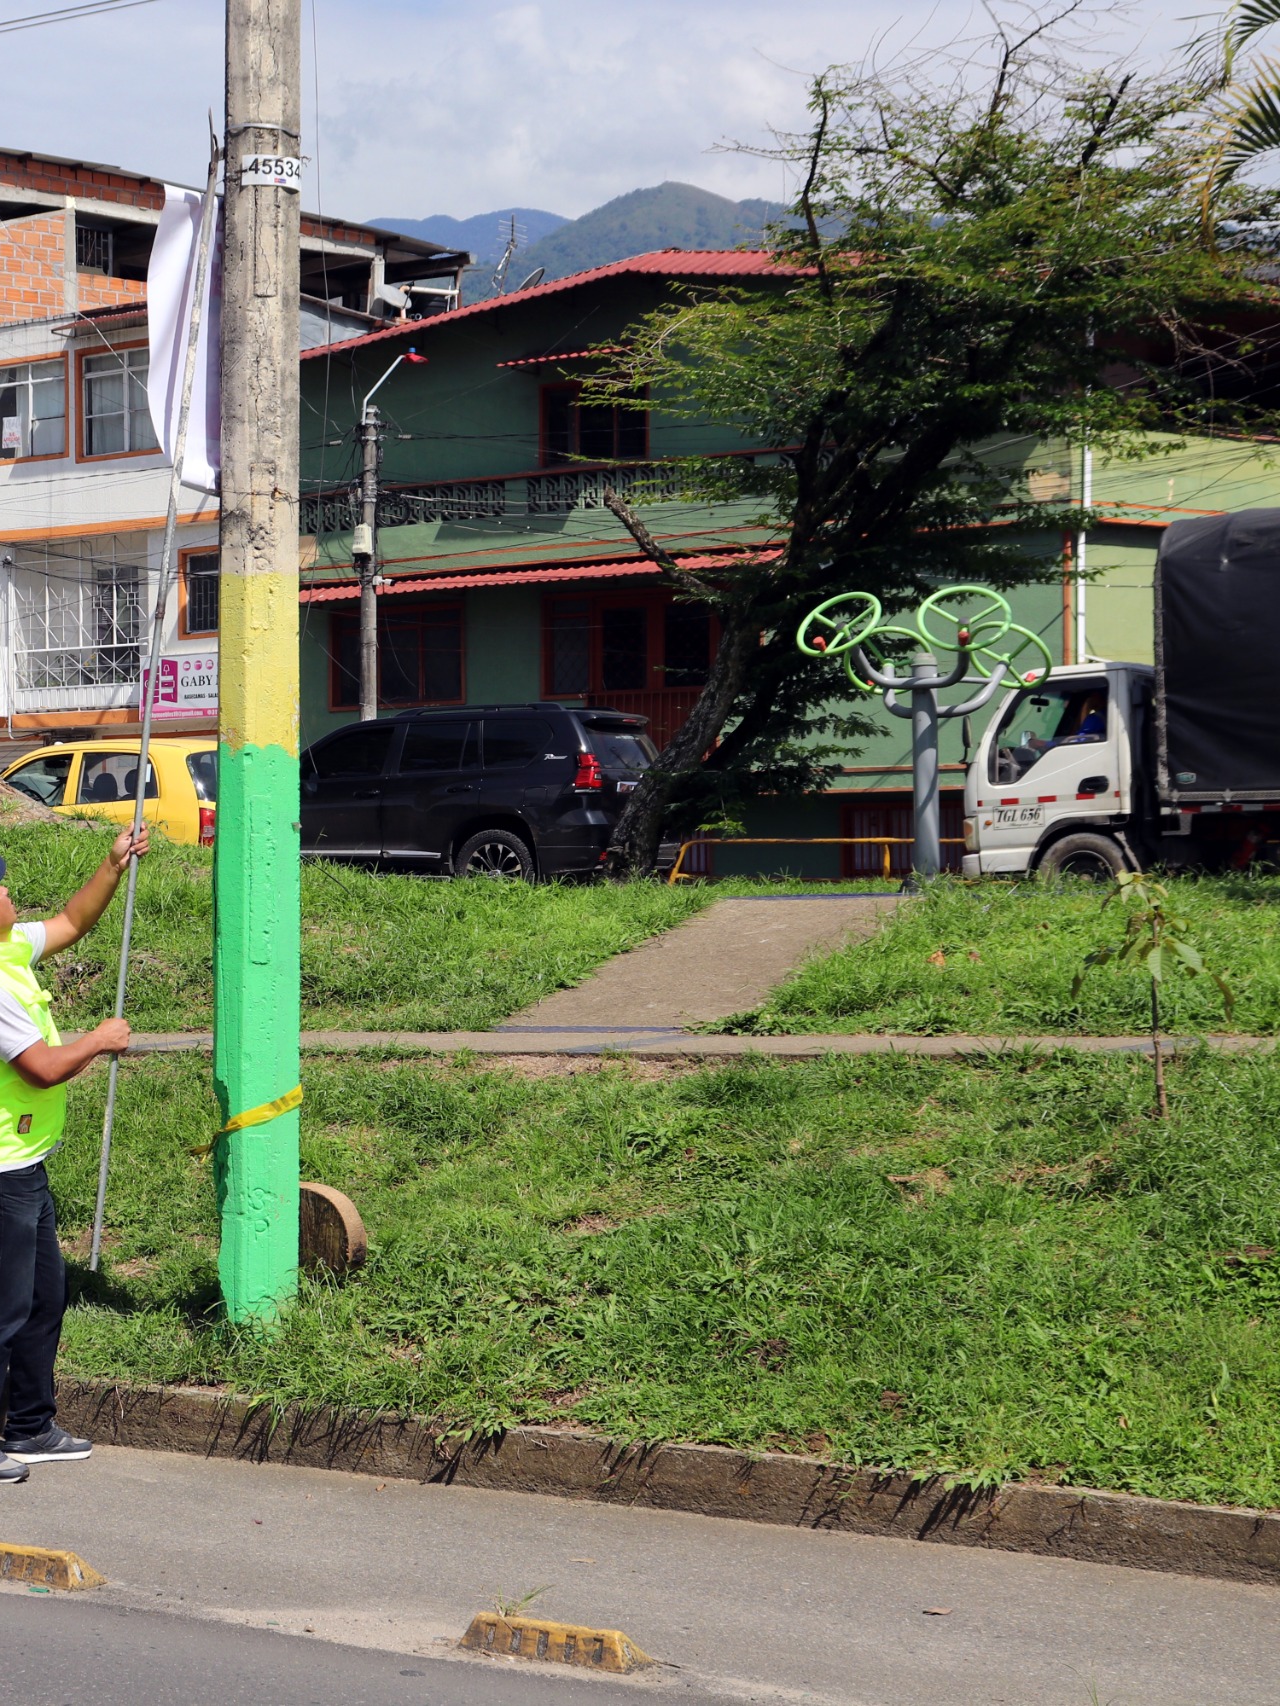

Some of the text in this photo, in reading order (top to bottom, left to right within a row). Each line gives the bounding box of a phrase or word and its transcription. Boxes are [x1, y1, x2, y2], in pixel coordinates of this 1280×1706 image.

[248, 157, 301, 179] 45534
[181, 675, 213, 687] GABY
[997, 808, 1042, 823] TGL 656
